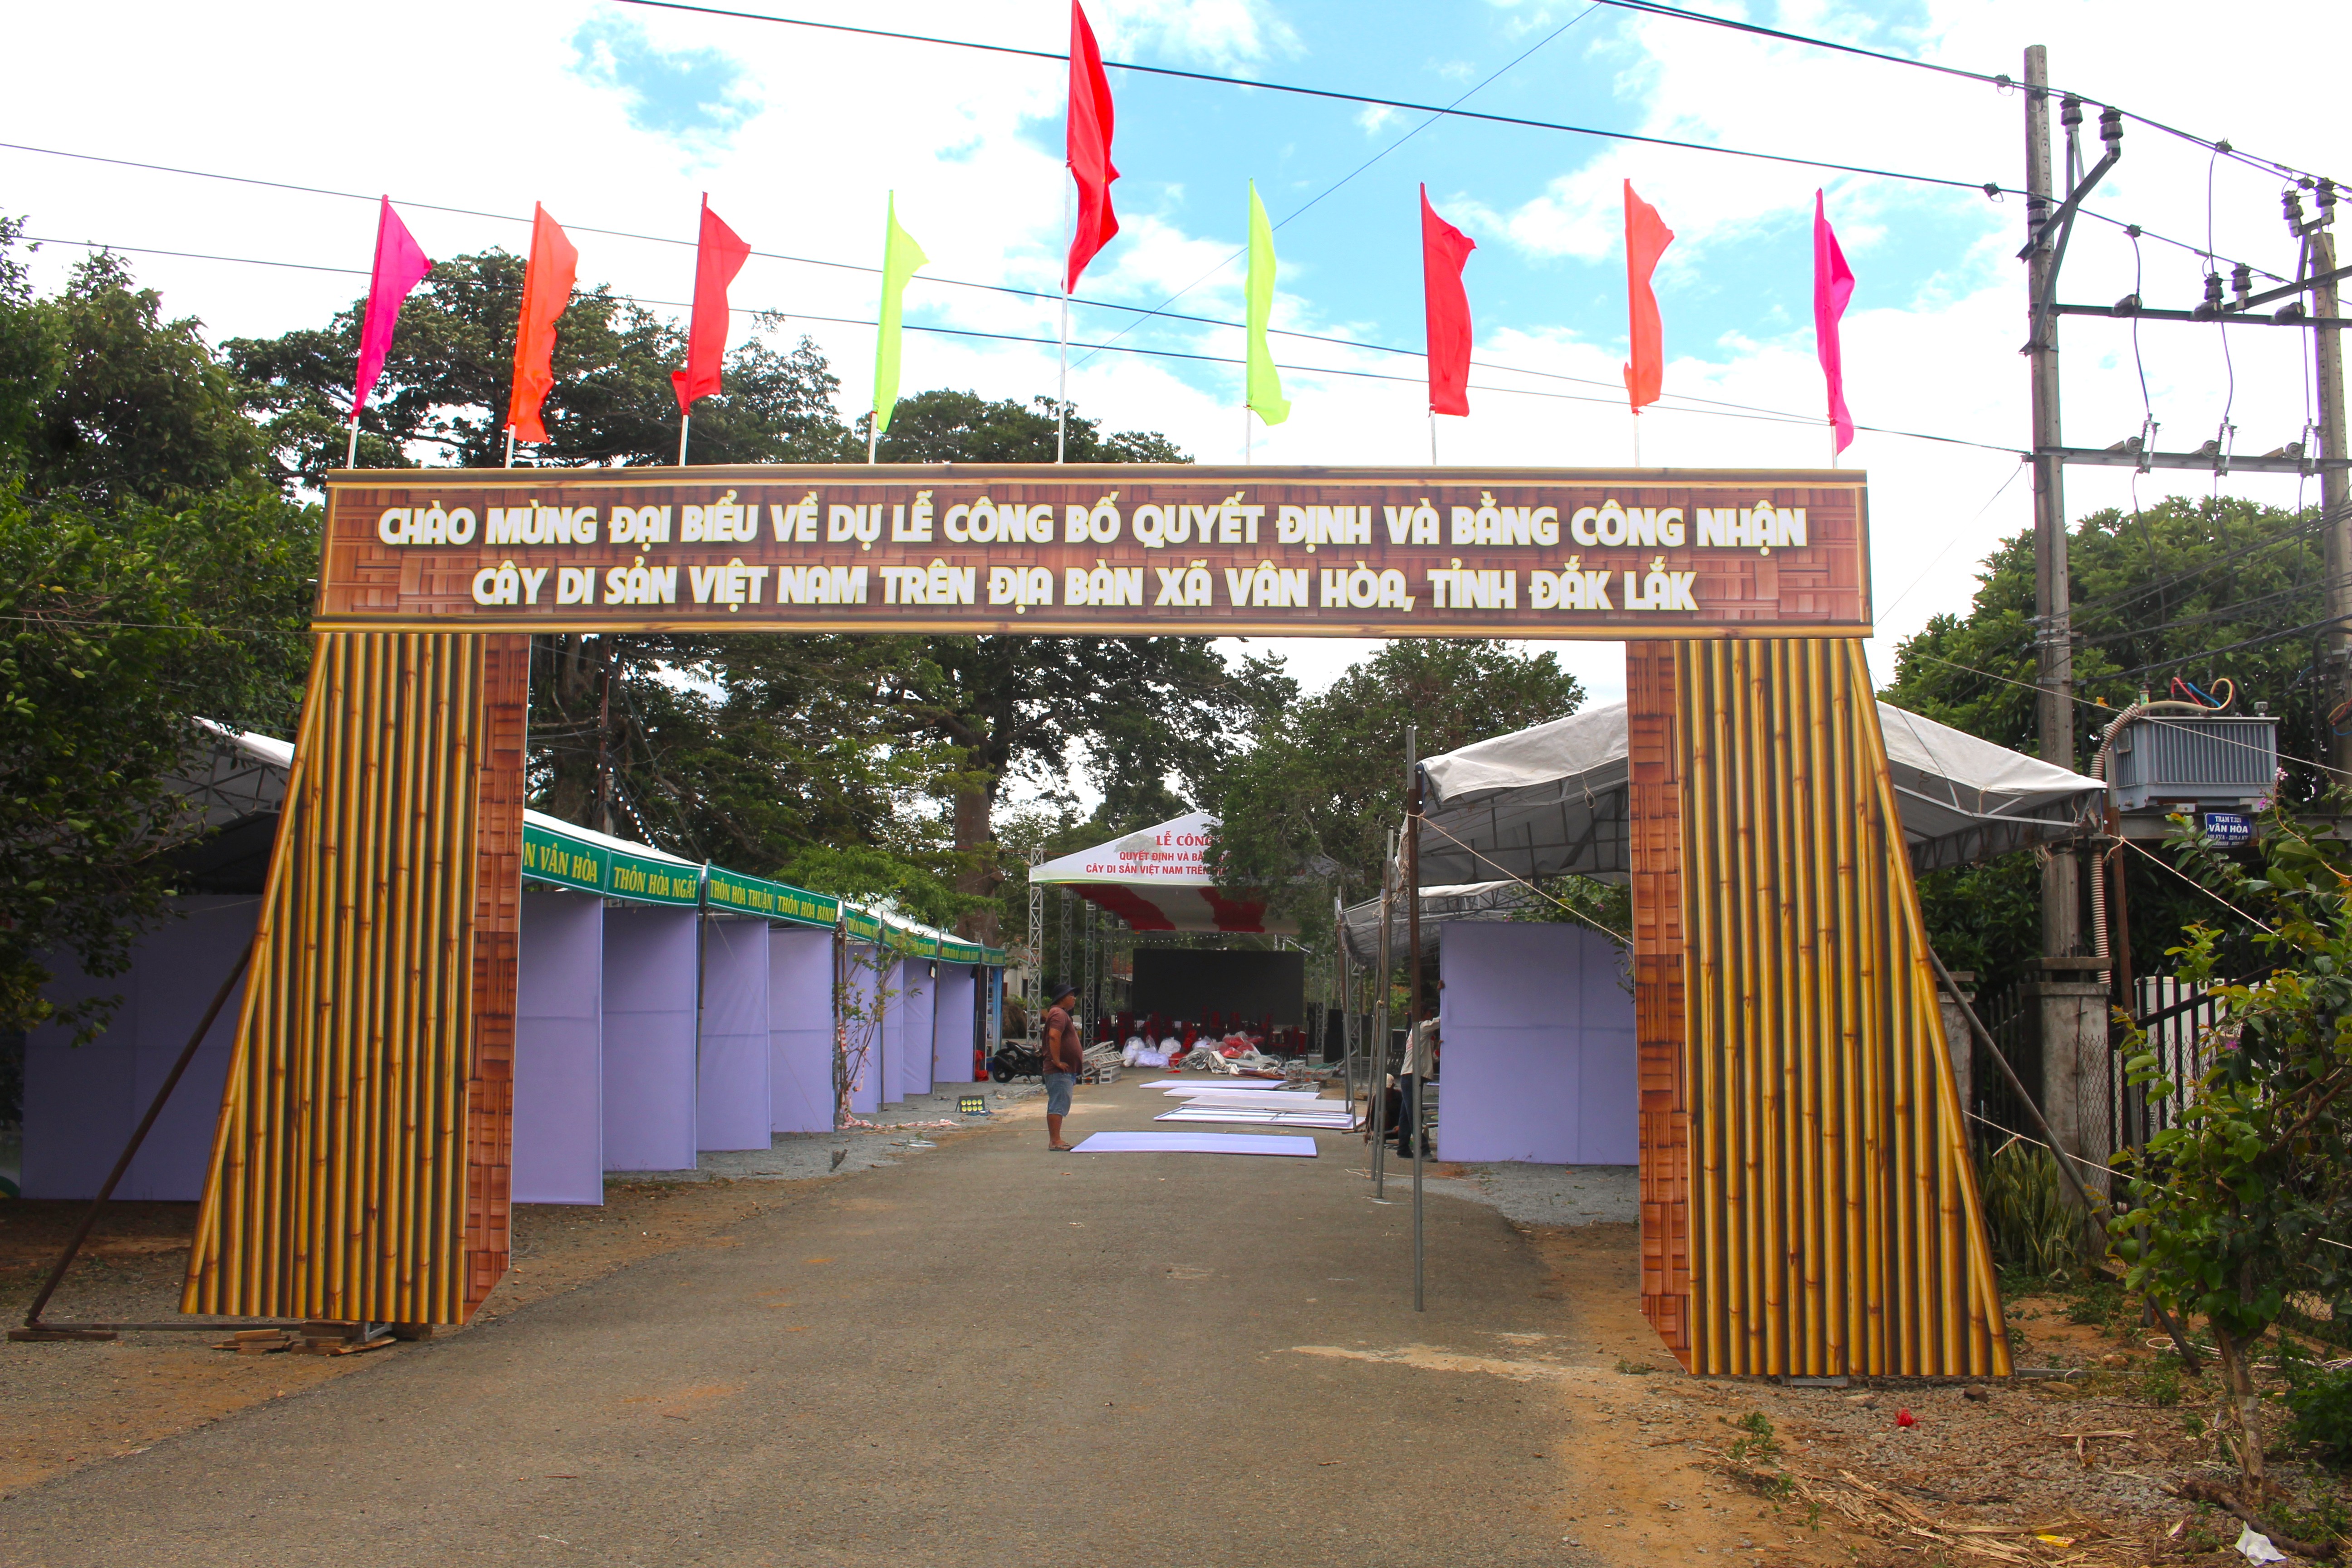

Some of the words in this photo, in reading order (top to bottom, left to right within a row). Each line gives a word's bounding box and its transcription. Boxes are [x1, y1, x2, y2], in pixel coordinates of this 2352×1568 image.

[378, 500, 476, 544] CHÀO
[485, 499, 598, 544] MỪNG
[608, 506, 671, 552] ĐẠI
[681, 489, 759, 543] BIỂU
[770, 491, 818, 542] VỀ
[827, 503, 882, 551] DỰ
[892, 490, 933, 543] LỄ
[944, 495, 1054, 543] CÔNG
[1065, 491, 1121, 543] BỐ
[1132, 491, 1265, 548] QUYẾT
[1275, 505, 1372, 553] ĐỊNH
[1383, 498, 1440, 544] VÀ
[1451, 491, 1559, 546] BẰNG
[1571, 499, 1685, 547] CÔNG
[1696, 500, 1807, 556] NHẬN
[472, 559, 549, 605] CÂY
[556, 567, 595, 604] DI
[604, 556, 677, 605] SẢN
[689, 557, 769, 612] VIỆT
[777, 565, 868, 604] NAM
[879, 558, 976, 605] TRÊN
[987, 566, 1054, 614] ĐỊA
[1064, 559, 1144, 605] BÀN
[1154, 559, 1212, 606] XÃ
[1224, 559, 1309, 607] VÂN
[1320, 560, 1416, 612] HÒA,
[1427, 558, 1516, 609] TỈNH
[1529, 555, 1614, 610] ĐẮK
[1624, 556, 1700, 611] LẮK
[1156, 831, 1172, 846] LỄ
[2209, 823, 2227, 833] VÂN
[2230, 824, 2248, 833] HÒA
[540, 843, 569, 876] VÂN
[572, 851, 598, 883] HÒA
[1086, 862, 1104, 873] CÂY
[1107, 865, 1116, 873] DI
[1119, 863, 1137, 874] SẢN
[1140, 864, 1160, 876] VIỆT
[1162, 866, 1183, 874] NAM
[1119, 849, 1149, 861] QUYẾT
[1152, 853, 1174, 862] ĐỊNH
[1177, 851, 1189, 861] VÀ
[614, 864, 646, 892] THÔN
[648, 869, 669, 896] HÒA
[672, 875, 696, 898] NGÃI
[710, 877, 730, 902] THÔN
[731, 882, 745, 905] HÒA
[748, 887, 773, 913] THUẬN
[778, 894, 799, 915] THÔN
[800, 898, 815, 919] HÒA
[817, 902, 835, 922] BÌNH
